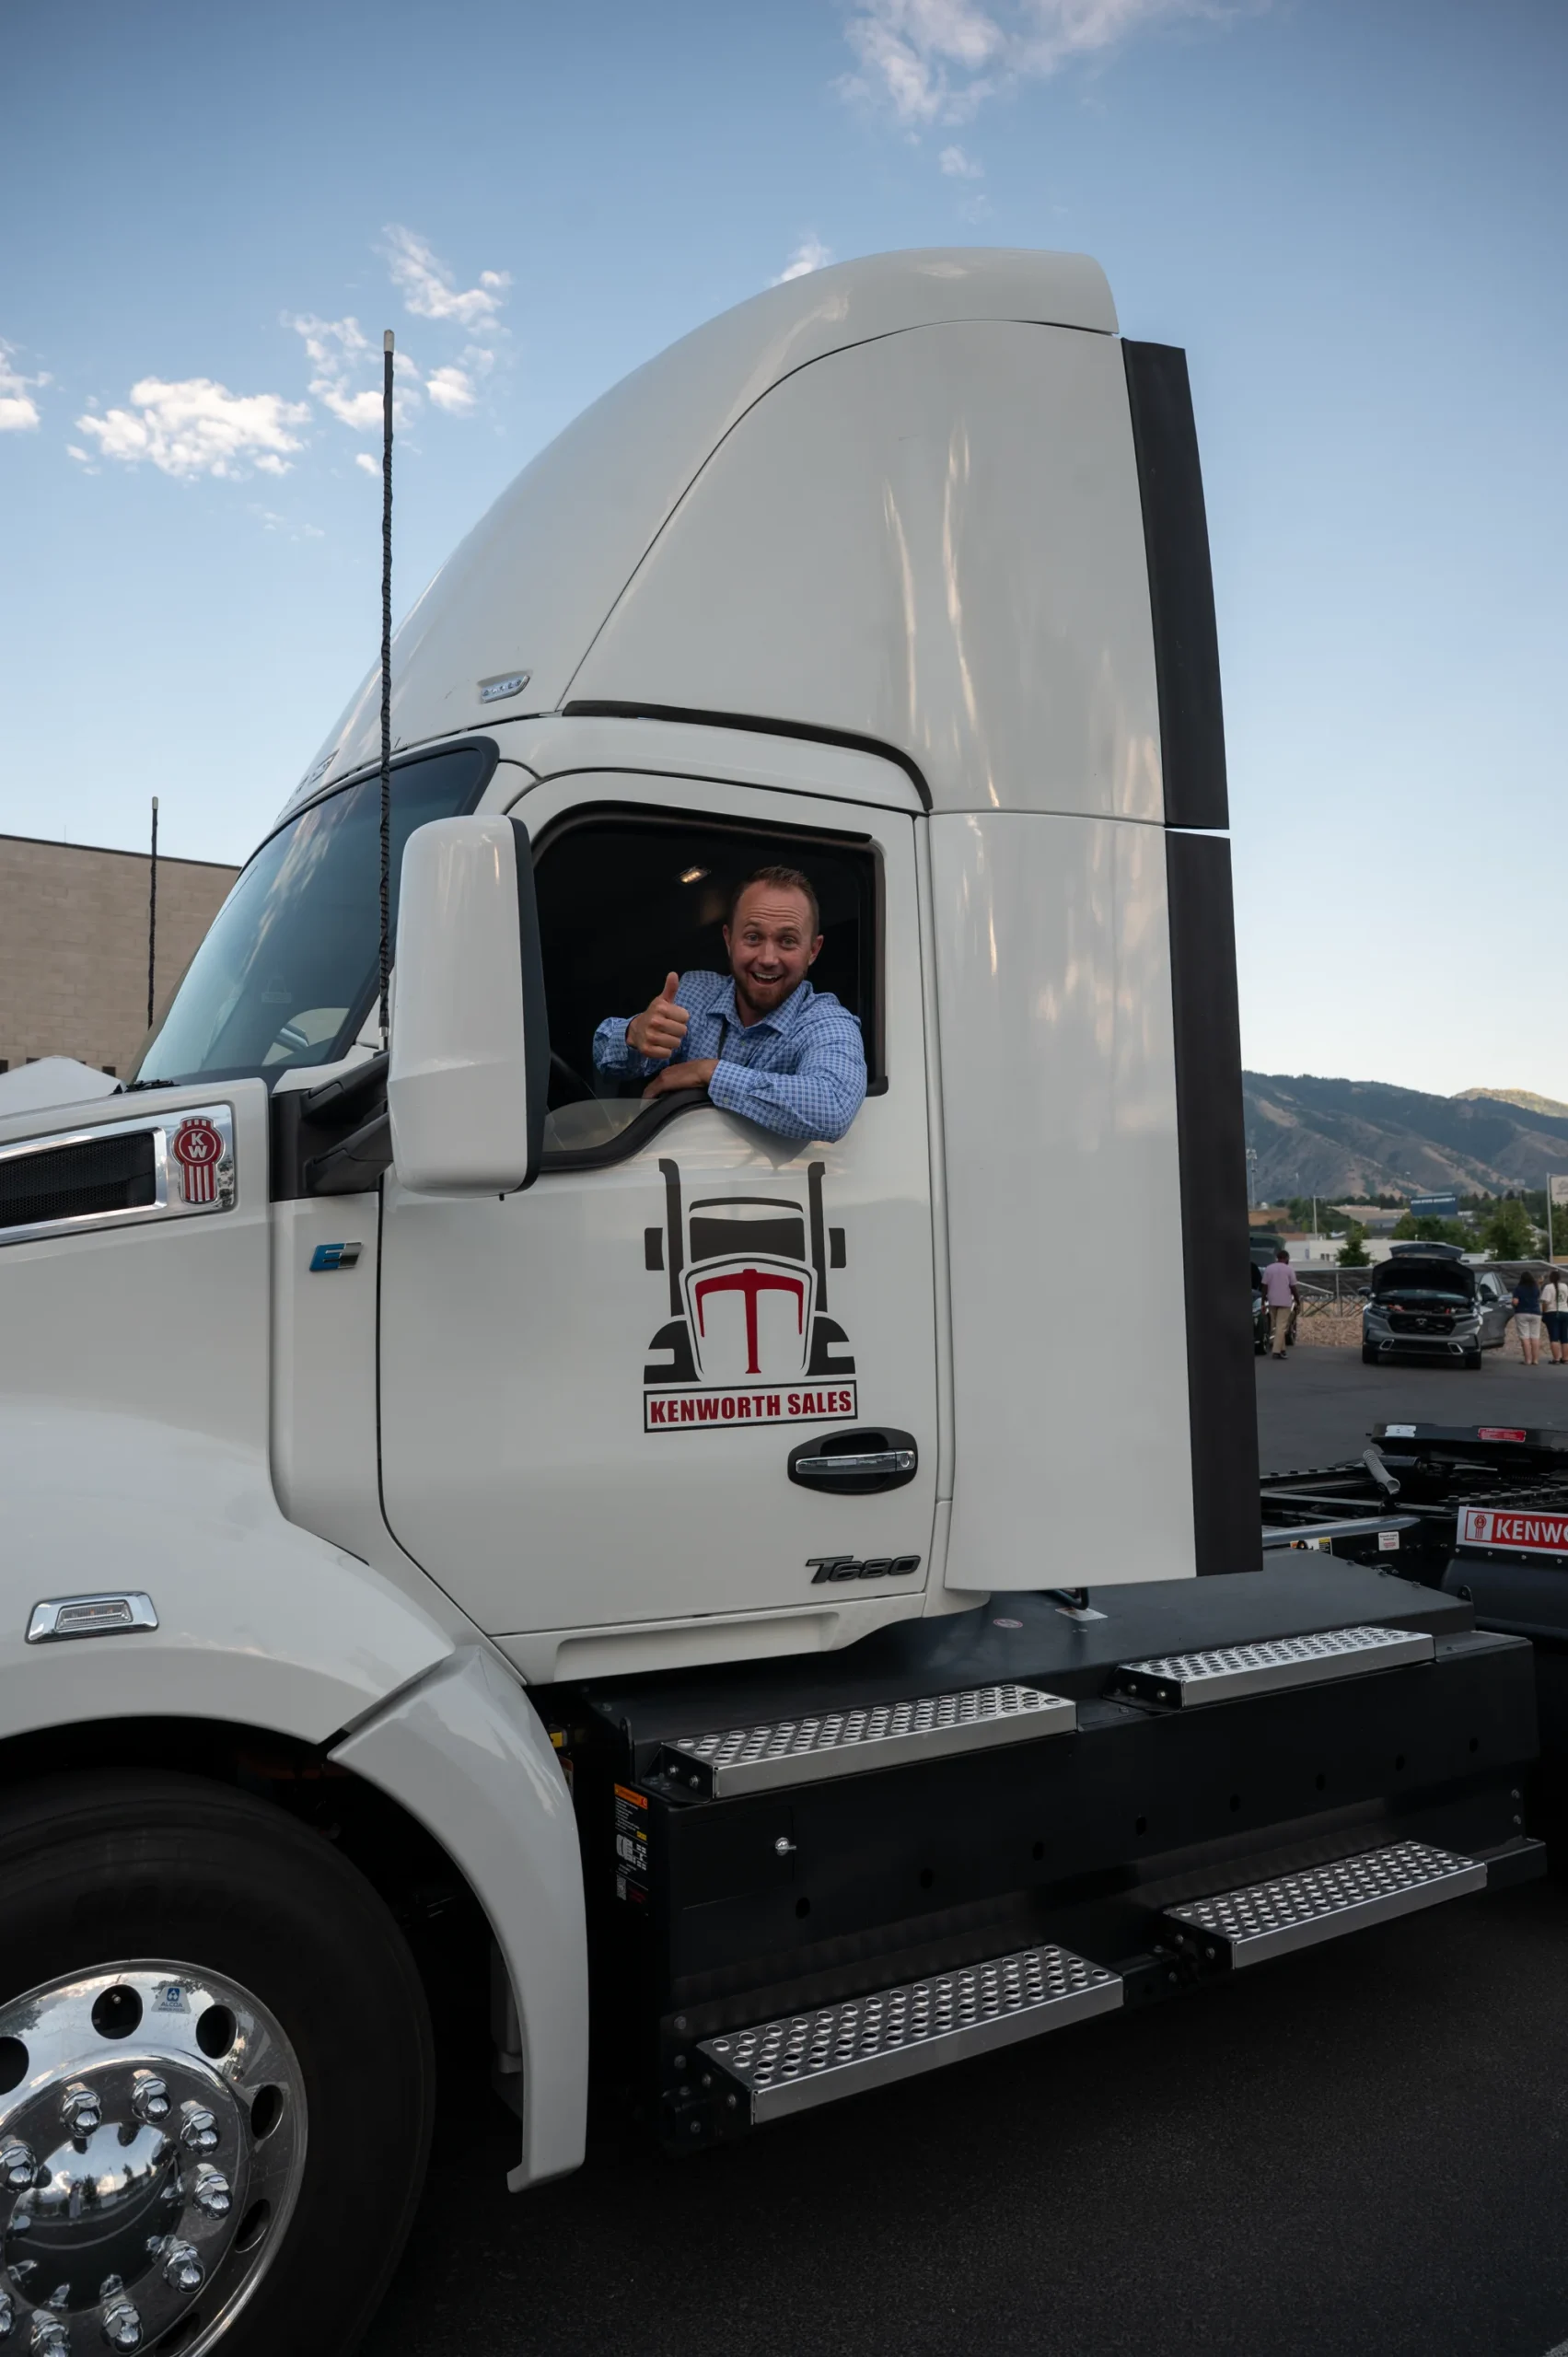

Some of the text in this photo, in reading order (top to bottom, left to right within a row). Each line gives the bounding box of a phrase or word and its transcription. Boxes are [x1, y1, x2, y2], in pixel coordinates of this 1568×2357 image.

[188, 1145, 208, 1158] W
[191, 1132, 204, 1146] K
[650, 1390, 852, 1423] KENWORTH SALES
[1496, 1518, 1568, 1543] KENW
[805, 1554, 922, 1584] T680
